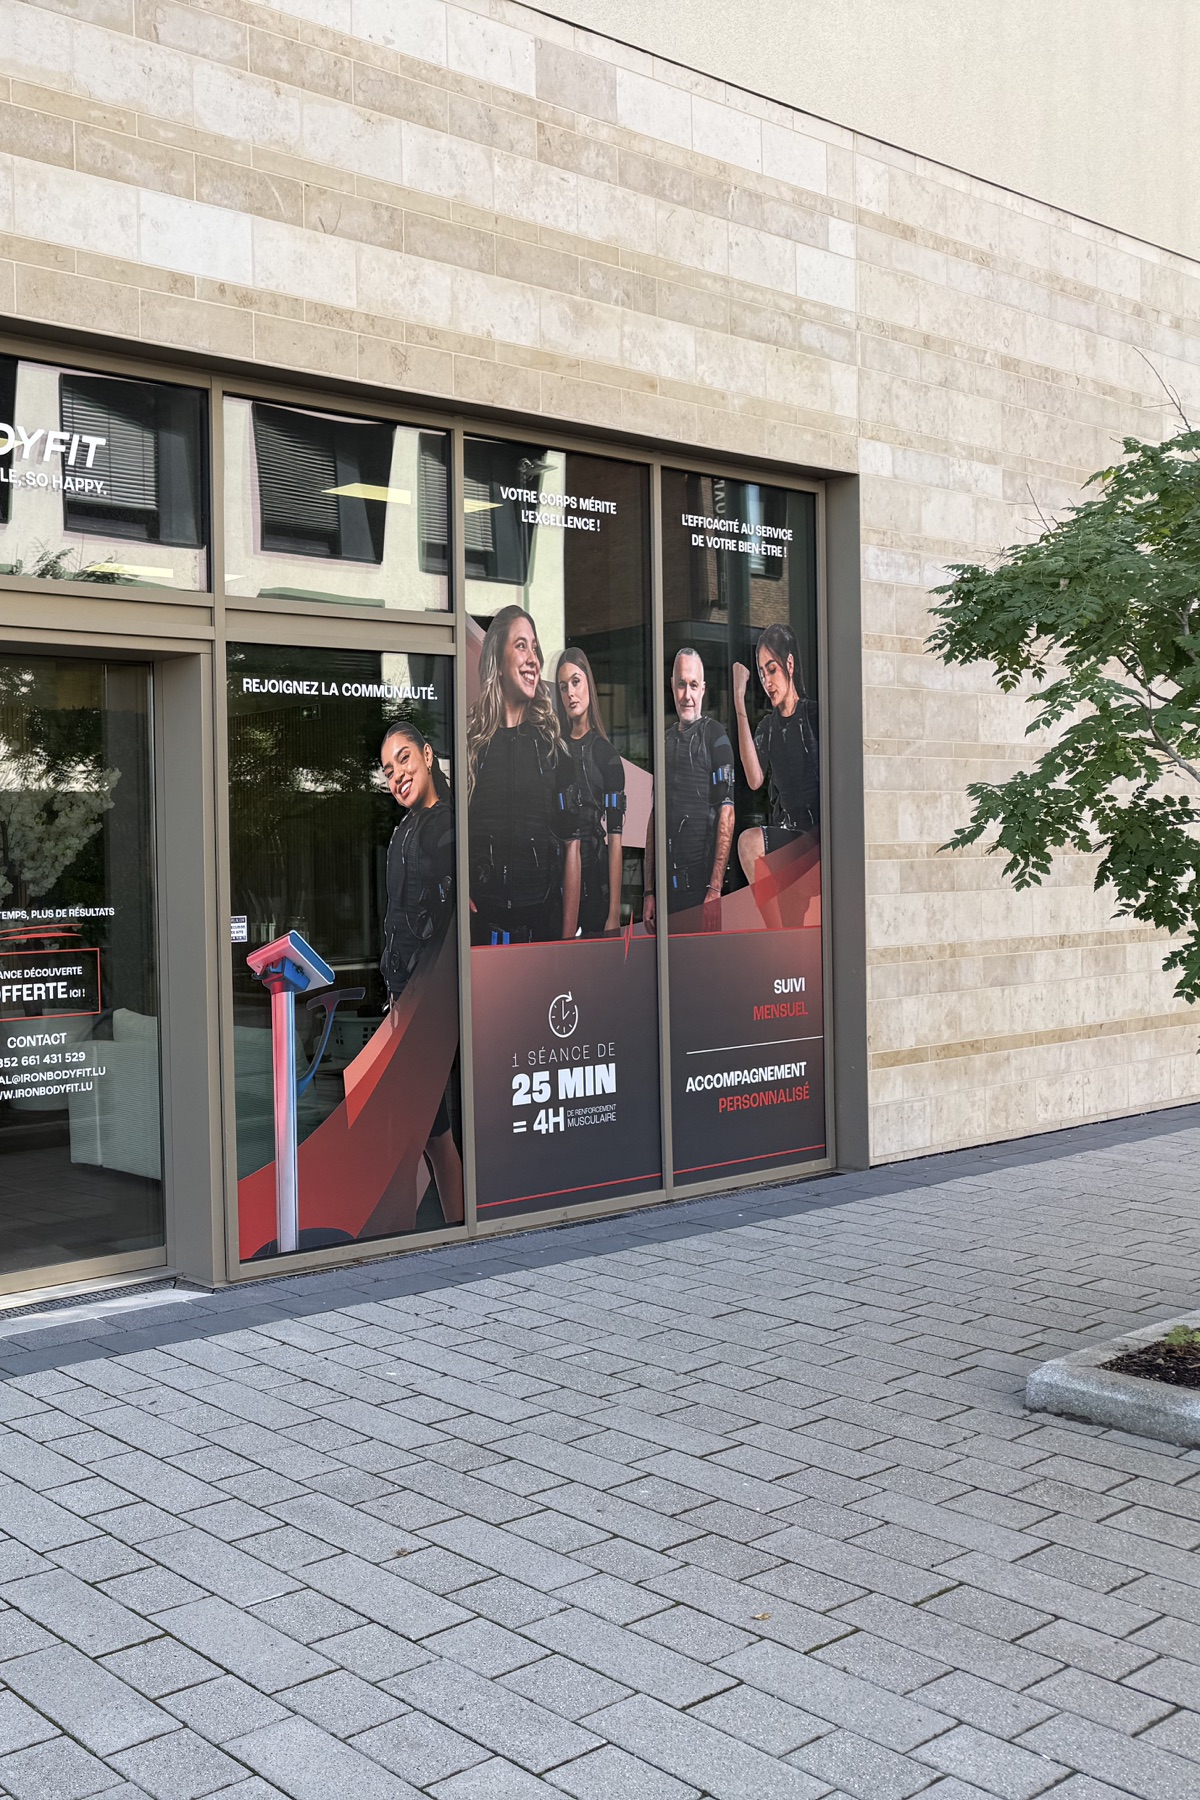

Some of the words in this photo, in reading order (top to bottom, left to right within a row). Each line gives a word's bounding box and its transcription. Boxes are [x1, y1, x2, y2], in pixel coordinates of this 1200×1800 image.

[25, 471, 49, 487] SO
[52, 474, 108, 496] HAPPY.
[500, 486, 538, 504] VOTRE
[539, 492, 578, 509] CORPS
[579, 496, 617, 515] MÉRITE
[521, 509, 596, 532] L'EXCELLENCE
[596, 519, 601, 532] !
[681, 513, 739, 534] L'EFFICACITÉ
[740, 522, 755, 536] AU
[755, 524, 793, 541] SERVICE
[691, 533, 705, 547] DE
[705, 535, 737, 551] VOTRE
[738, 540, 783, 558] BIEN-ÊTRE
[783, 546, 788, 558] !
[242, 677, 319, 695] REJOIGNEZ
[321, 682, 339, 696] LA
[341, 683, 438, 700] COMMUNAUTÉ.
[31, 909, 54, 919] PLUS
[55, 908, 68, 918] DE
[68, 906, 115, 918] RÉSULTATS
[23, 966, 83, 978] DÉCOUVERTE
[69, 989, 81, 998] ICI
[82, 988, 86, 998] !
[773, 976, 806, 994] SUIVI
[753, 1001, 809, 1021] MENSUEL
[7, 1032, 67, 1049] CONTACT
[21, 1055, 40, 1067] 661
[42, 1053, 62, 1064] 431
[64, 1051, 86, 1063] 529
[511, 1052, 520, 1068] 1
[527, 1044, 591, 1066] SÉANCE
[597, 1041, 616, 1058] DE
[511, 1070, 552, 1107] 25
[557, 1062, 617, 1100] MIN
[685, 1061, 807, 1093] ACCOMPAGNEMENT
[718, 1081, 810, 1113] PERSONNALISÉ
[512, 1120, 527, 1134] =
[533, 1106, 565, 1135] 4H
[567, 1109, 576, 1117] DE
[575, 1103, 617, 1116] RENFORCEMENT
[567, 1111, 617, 1128] MUSCULAIRE
